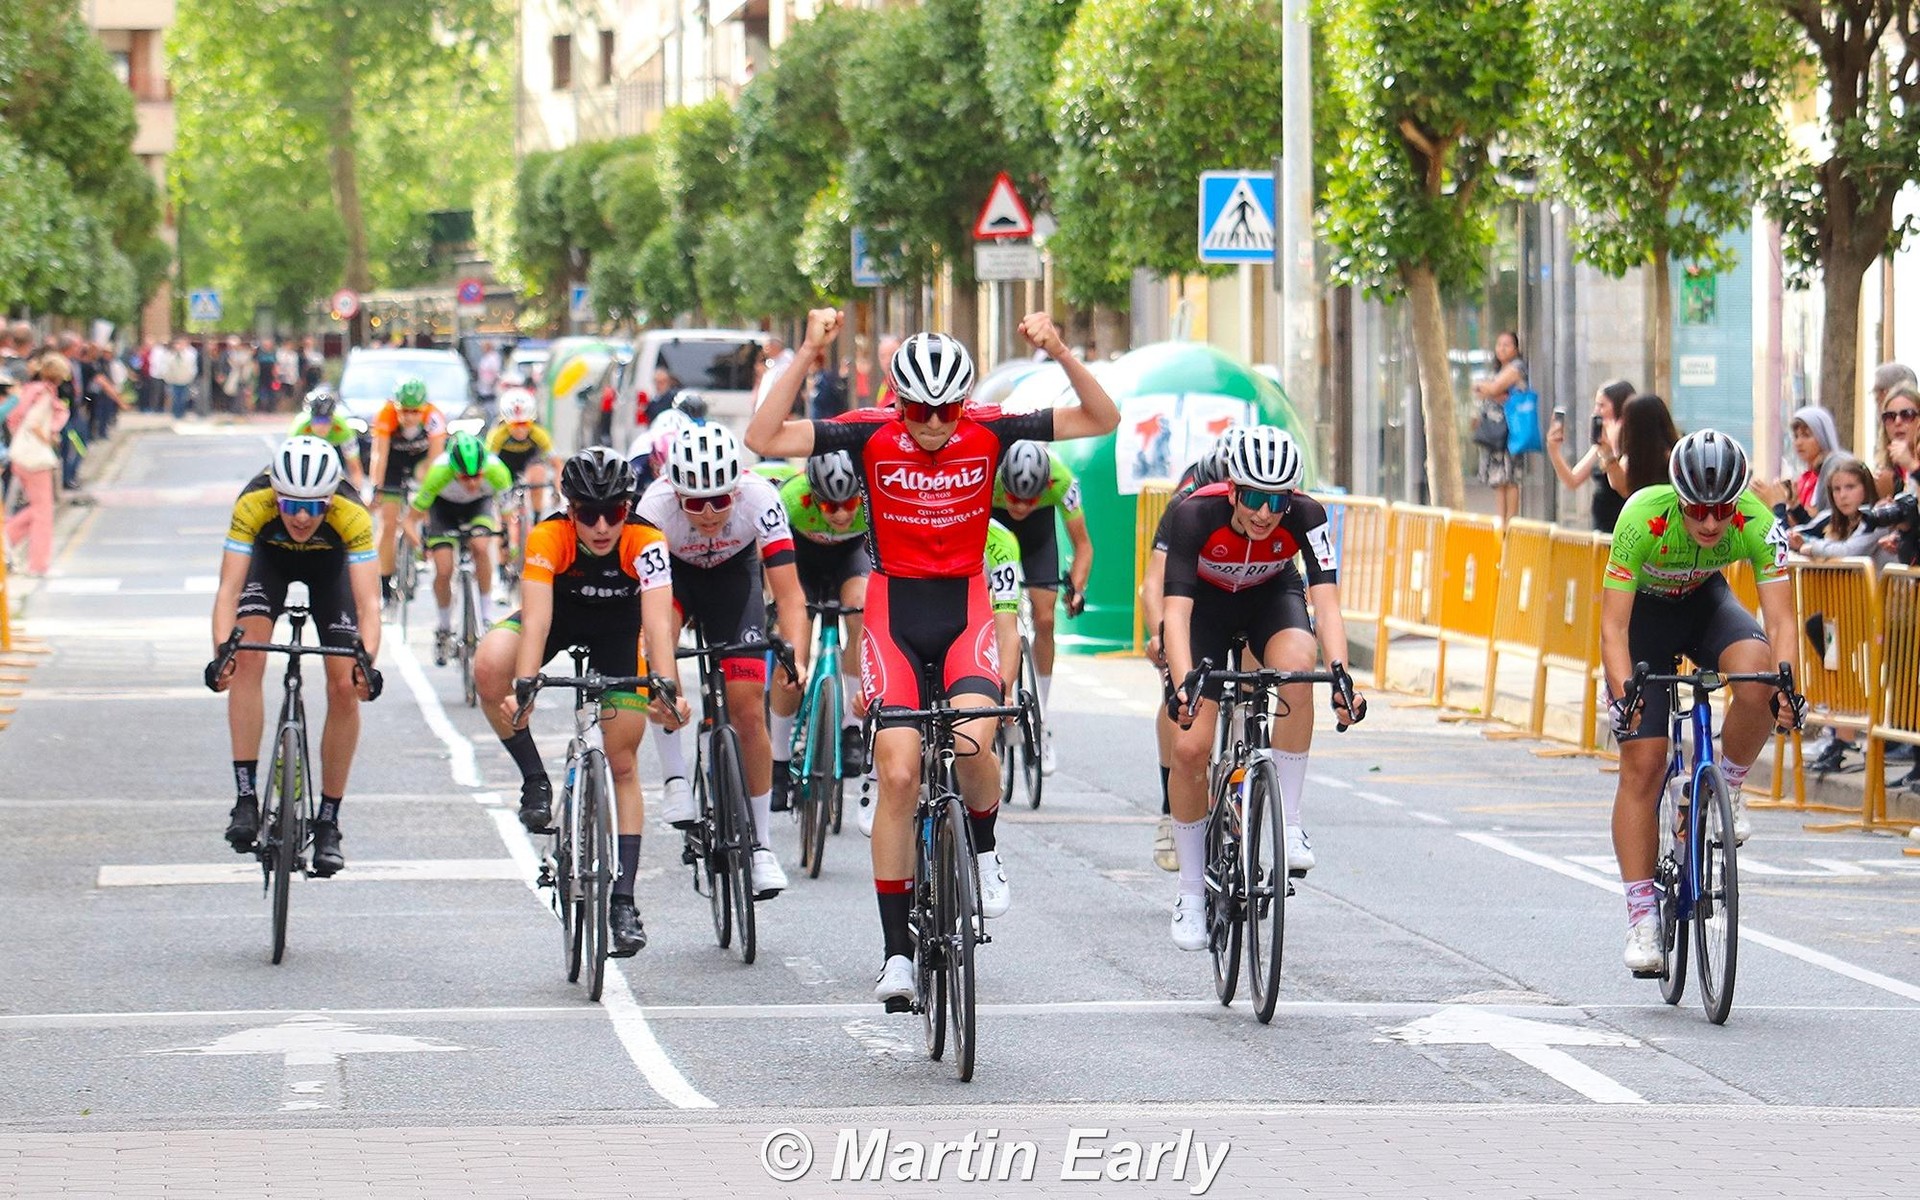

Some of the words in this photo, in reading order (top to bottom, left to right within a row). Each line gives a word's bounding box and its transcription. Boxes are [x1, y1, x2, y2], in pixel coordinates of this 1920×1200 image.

[881, 466, 984, 491] Albéniz
[894, 514, 930, 525] VASCO
[640, 547, 666, 575] 33
[992, 566, 1015, 592] 39
